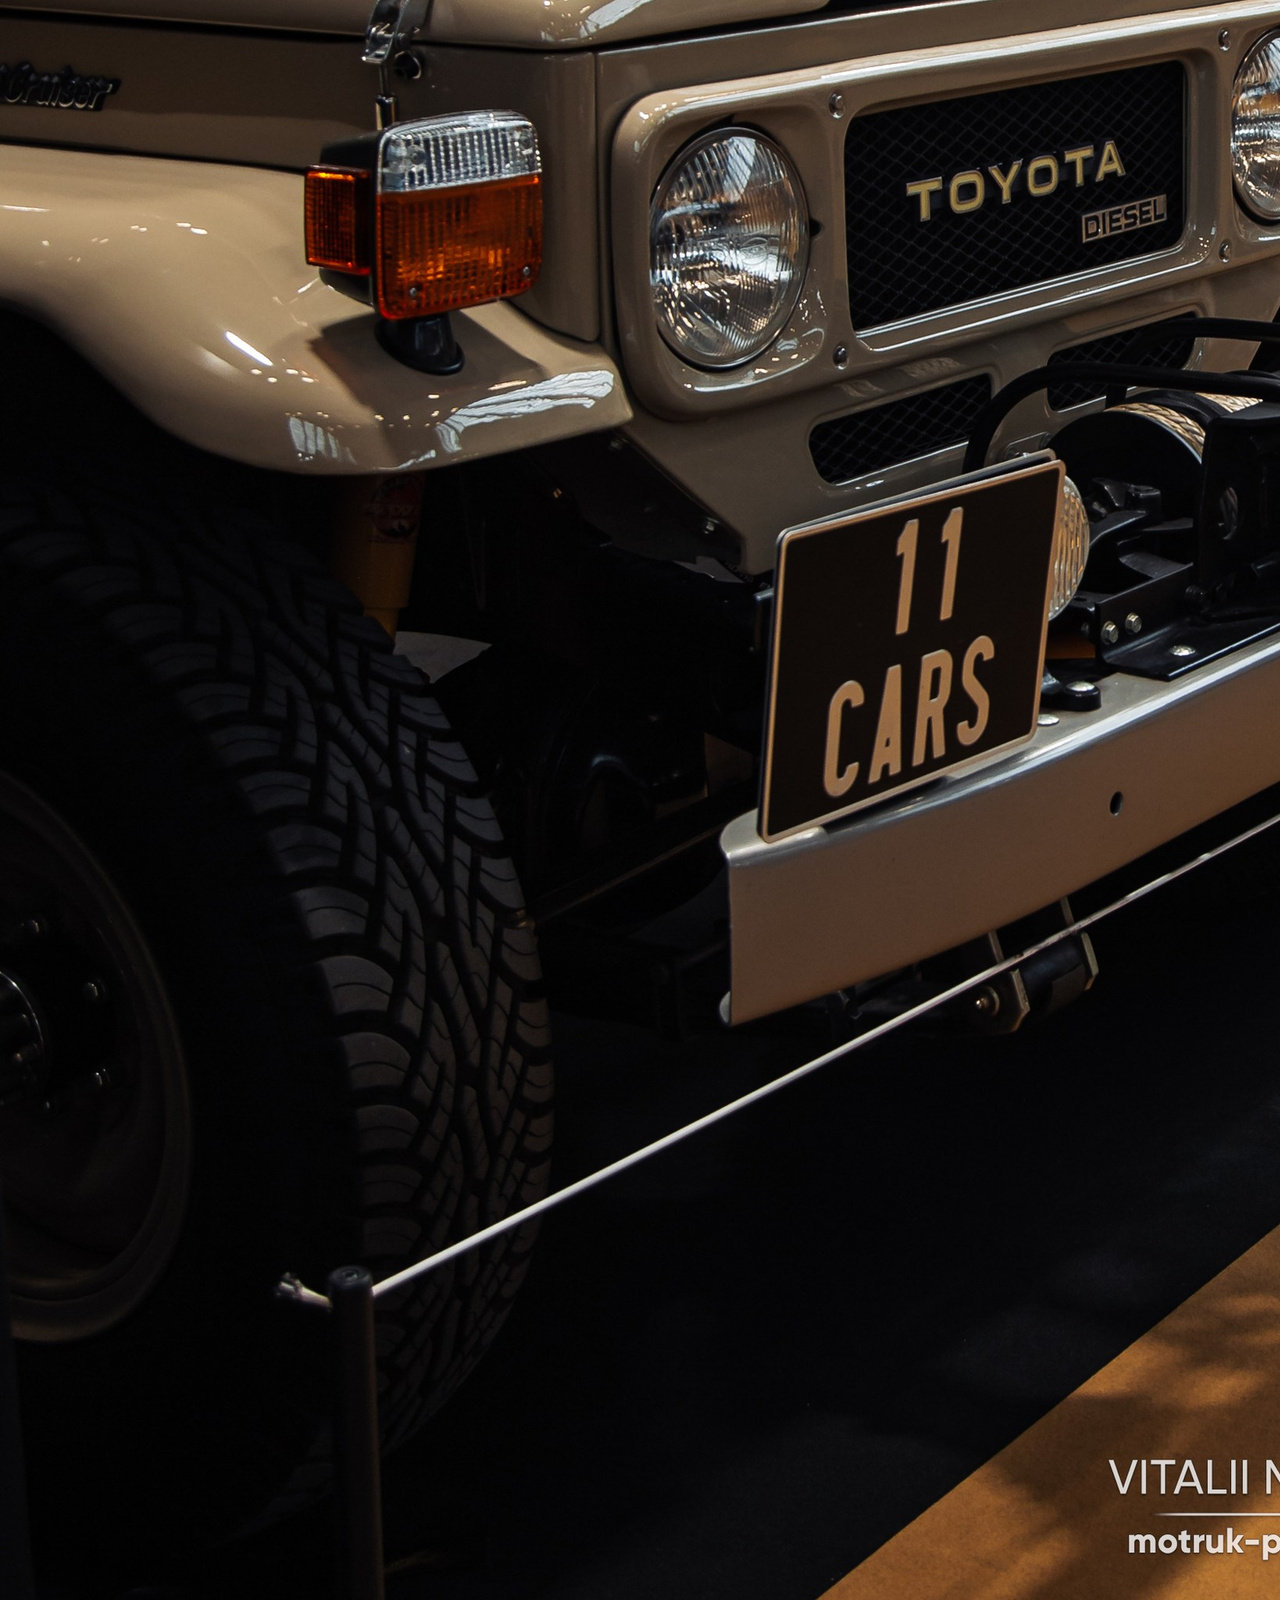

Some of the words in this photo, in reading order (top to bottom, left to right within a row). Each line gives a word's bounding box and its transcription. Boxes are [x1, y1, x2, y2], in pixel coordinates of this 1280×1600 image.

[906, 140, 1126, 222] TOYOTA
[1083, 196, 1167, 242] DIESEL
[895, 506, 964, 636] 11
[823, 635, 995, 798] CARS
